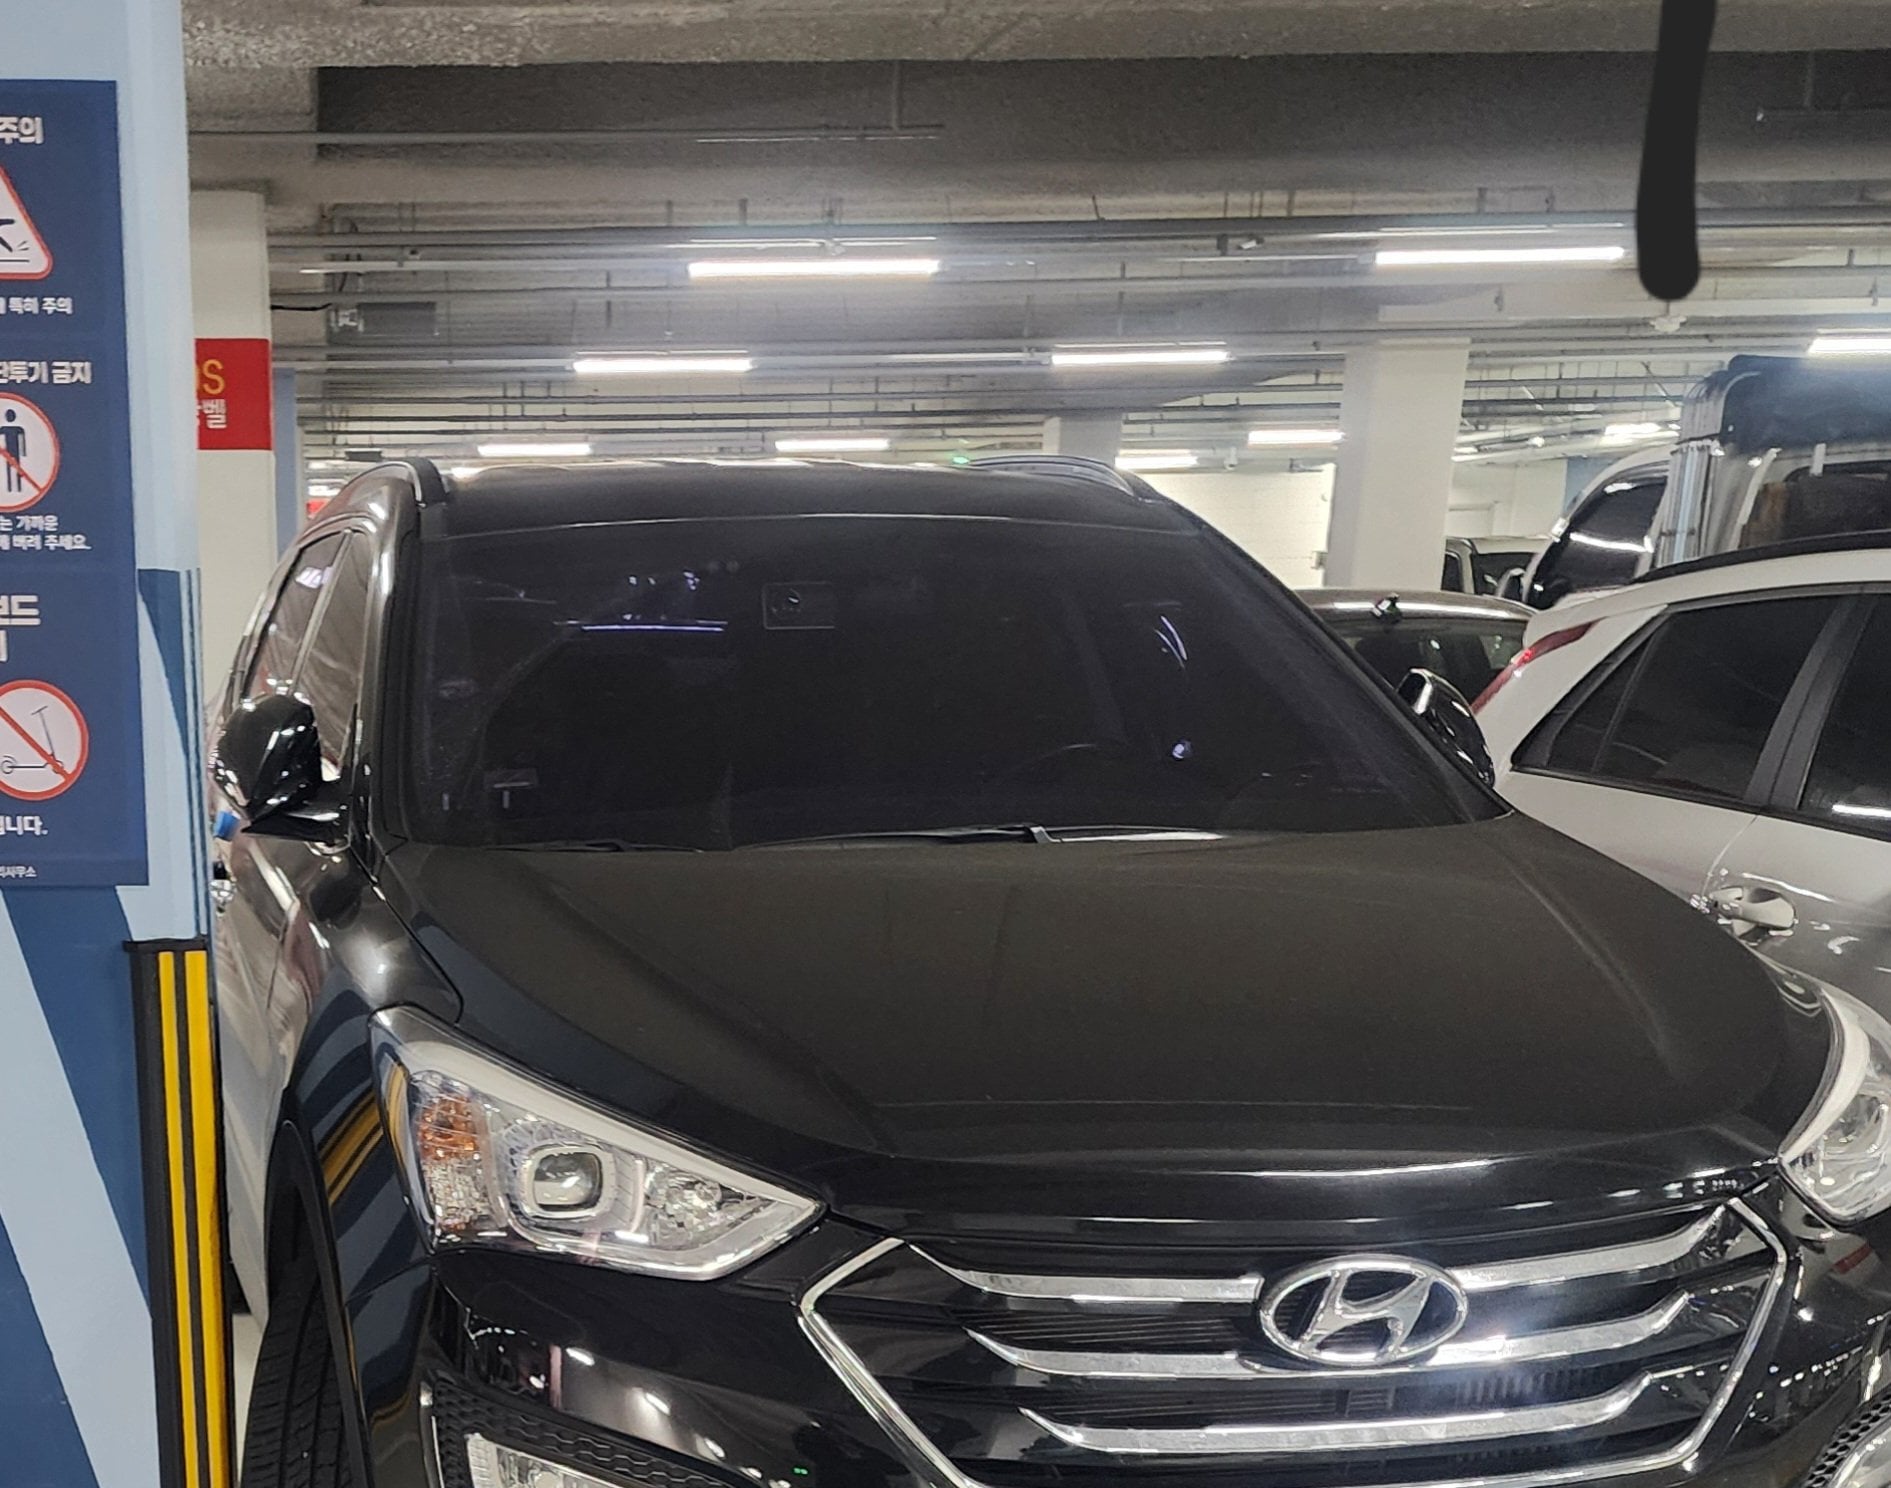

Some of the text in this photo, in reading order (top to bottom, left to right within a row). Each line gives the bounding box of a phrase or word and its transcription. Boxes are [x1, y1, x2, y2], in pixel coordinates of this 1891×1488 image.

[0, 116, 44, 144] 주의
[41, 297, 73, 315] 주의
[51, 361, 92, 384] 금지
[197, 359, 225, 395] S
[197, 399, 227, 429] 벨
